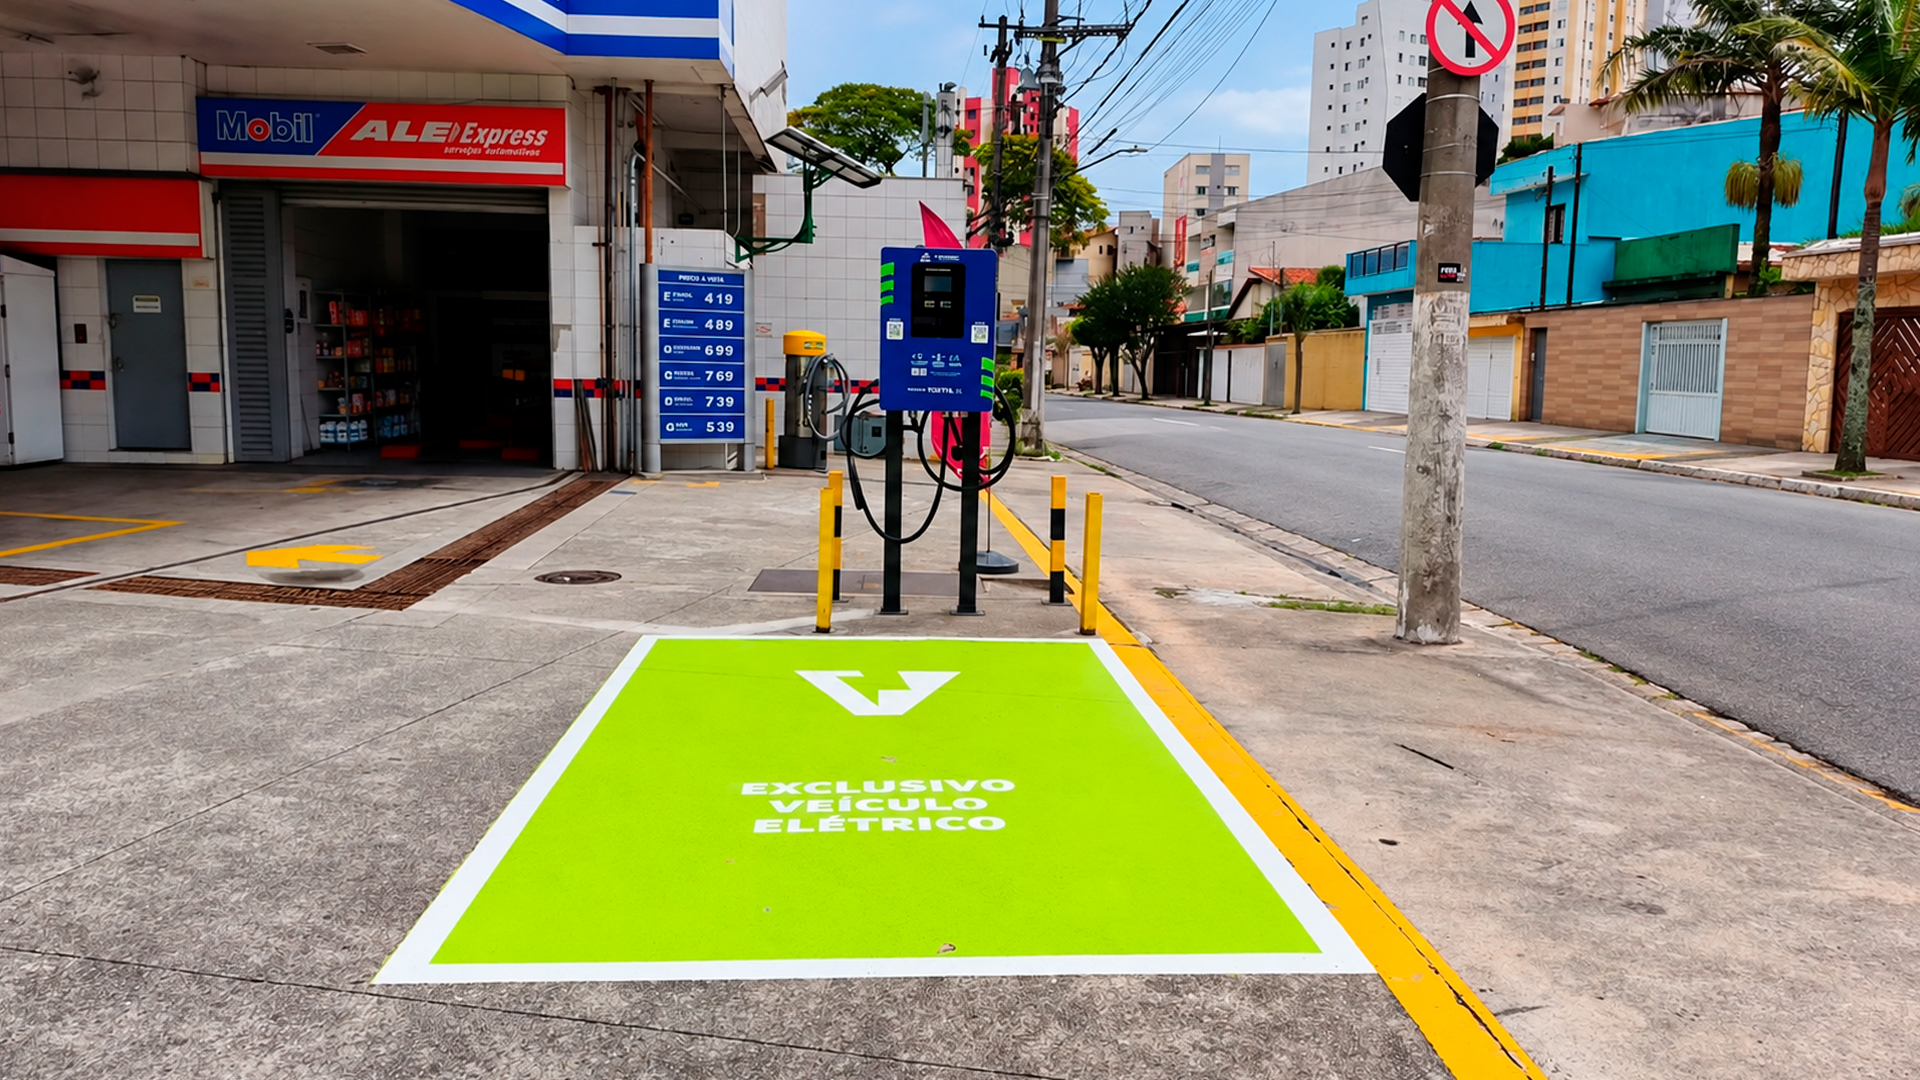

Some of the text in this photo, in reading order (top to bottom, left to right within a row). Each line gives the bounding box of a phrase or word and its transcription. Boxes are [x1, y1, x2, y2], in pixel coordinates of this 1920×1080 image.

[216, 109, 314, 143] Mobil
[350, 119, 548, 148] ALE Express
[663, 291, 671, 302] E
[704, 292, 733, 305] 419
[663, 318, 671, 328] E
[704, 318, 733, 331] 489
[704, 344, 734, 356] 699
[704, 370, 734, 381] 769
[705, 395, 735, 408] 739
[706, 421, 735, 433] 539
[741, 779, 1015, 796] EXCLUSIVO
[769, 796, 988, 813] VEÍCULO
[753, 815, 1006, 834] ELÉTRICO
